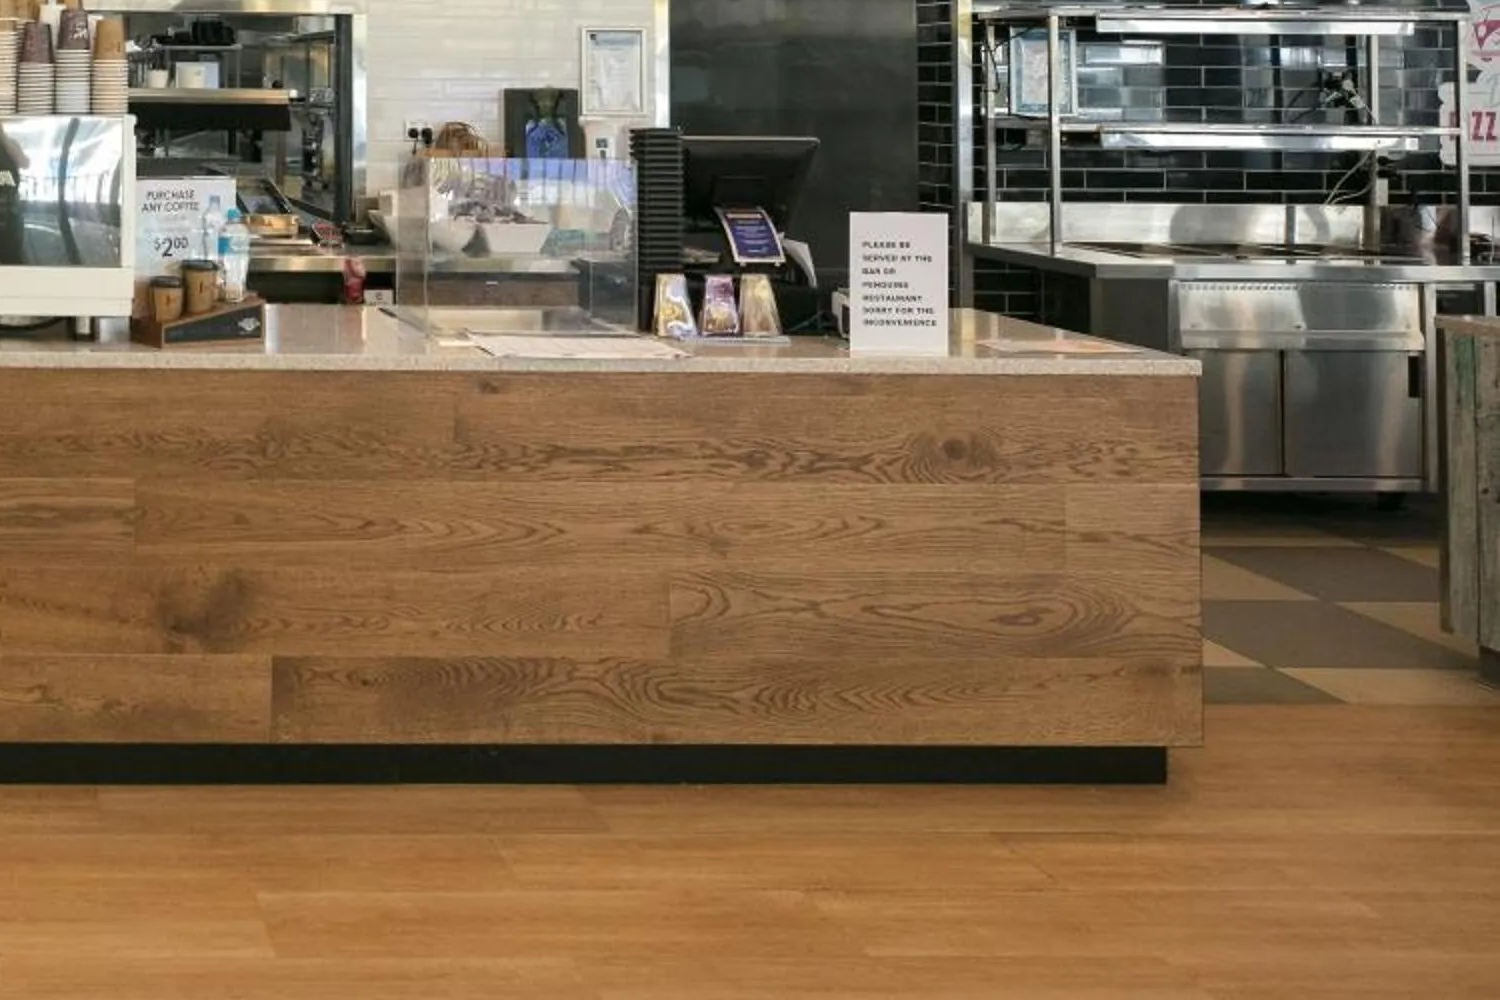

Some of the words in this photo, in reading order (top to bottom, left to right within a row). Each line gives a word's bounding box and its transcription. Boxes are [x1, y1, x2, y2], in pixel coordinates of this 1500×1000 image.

[146, 190, 196, 200] PURCHASE
[141, 202, 161, 212] ANY
[165, 201, 200, 212] COFFEE
[861, 241, 896, 249] PLEASE
[862, 294, 922, 302] RESTAURANT
[863, 319, 937, 327] INCONVENIENCE
